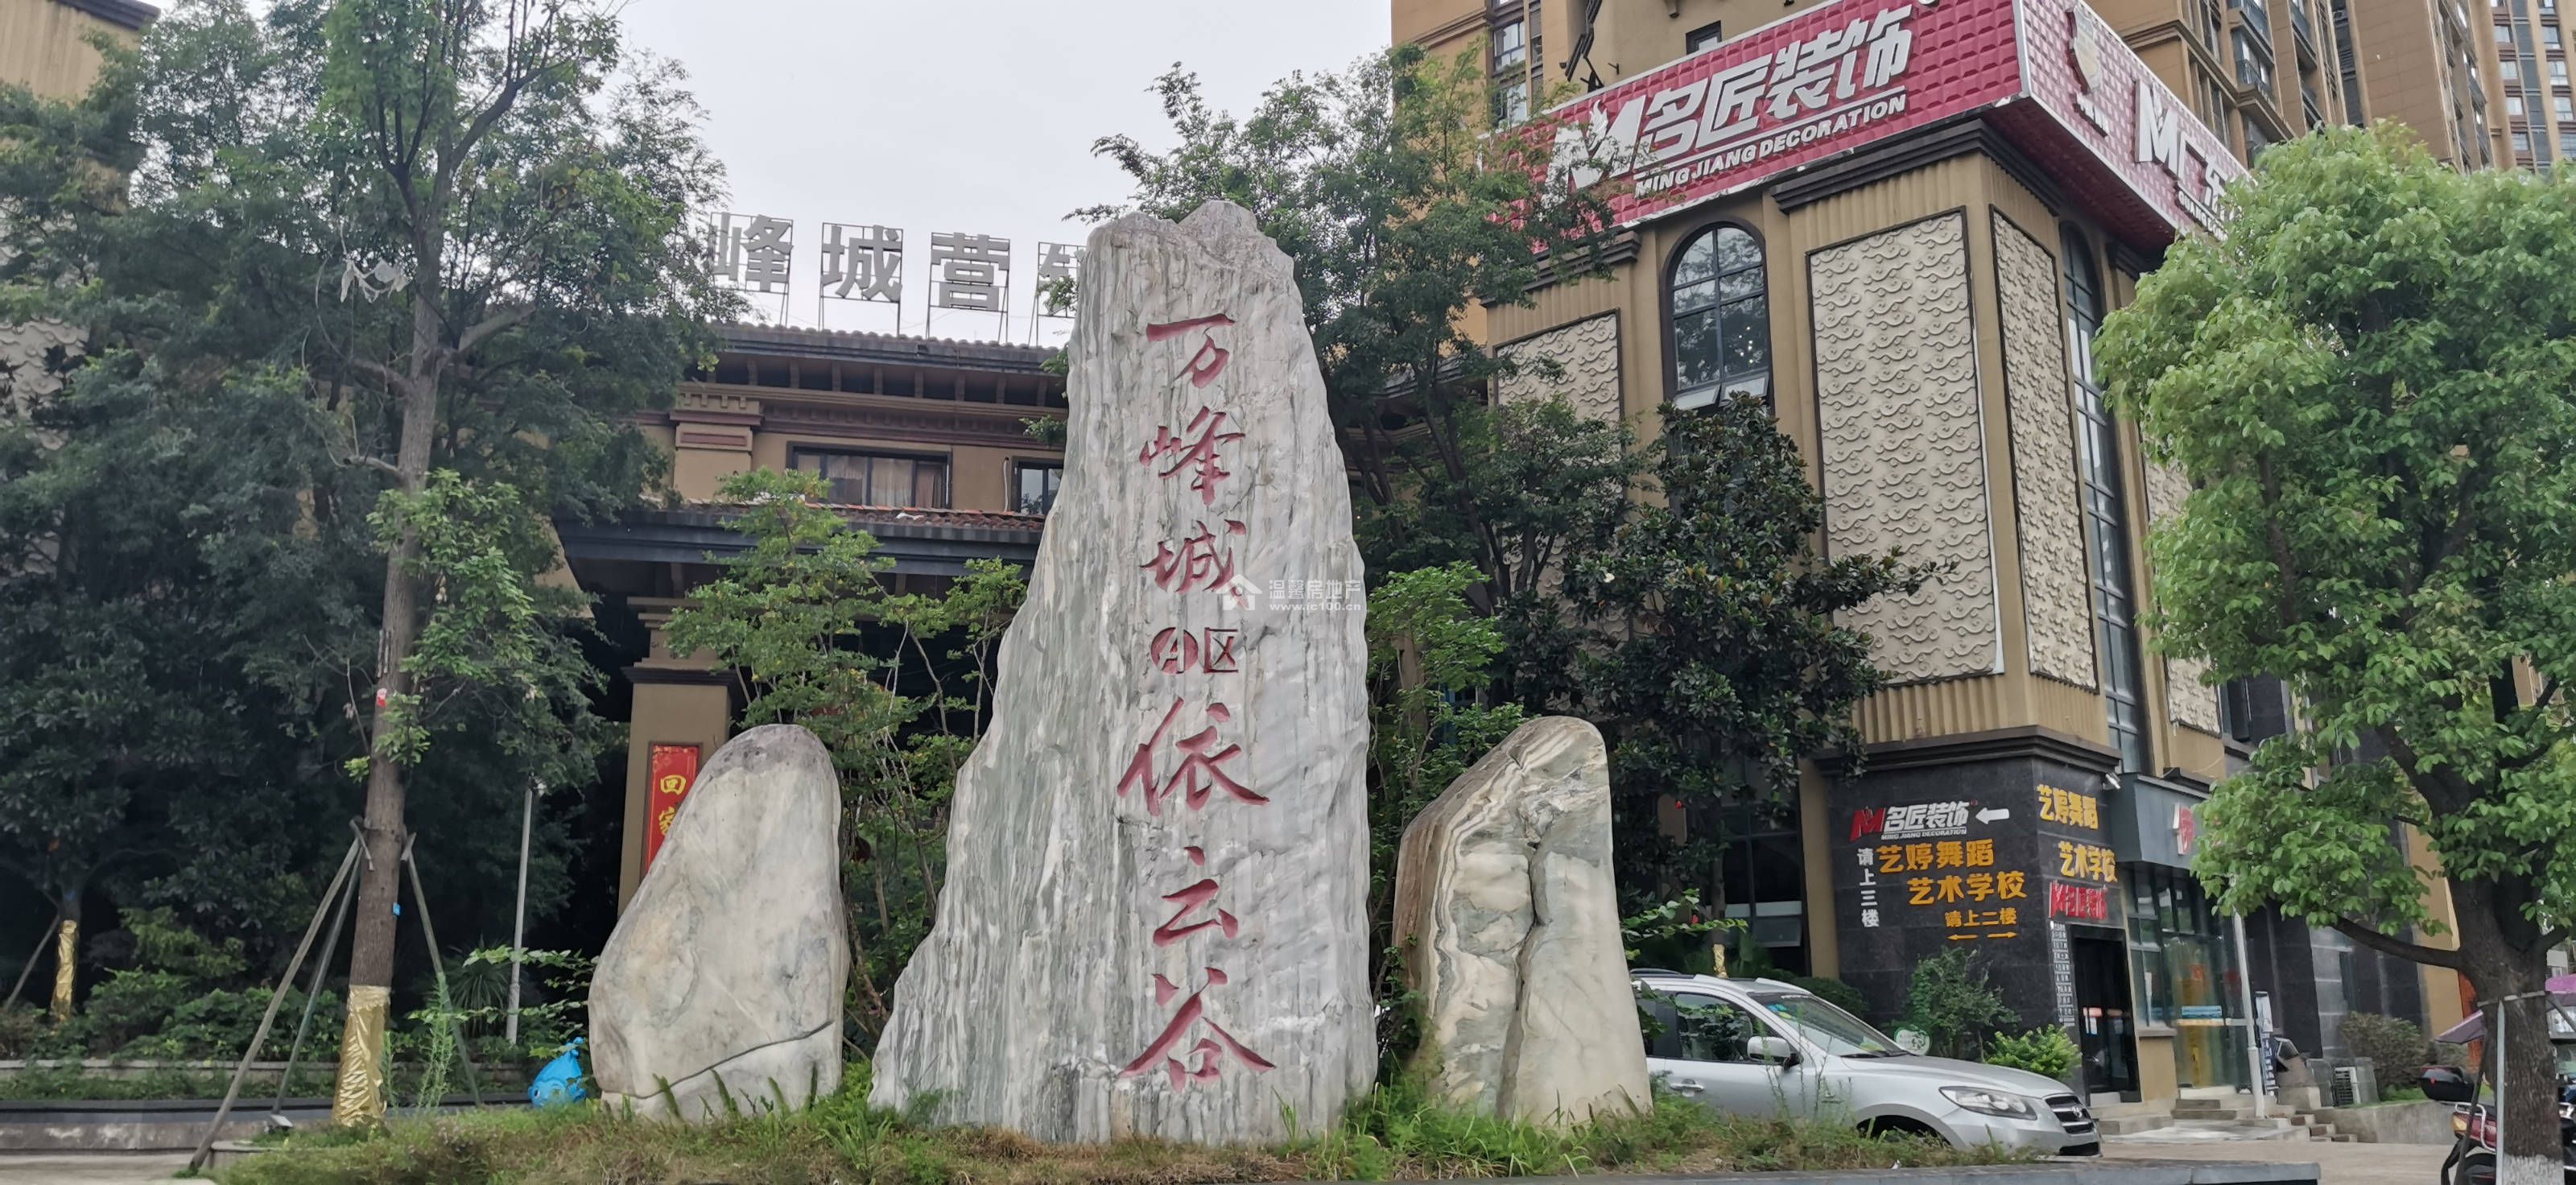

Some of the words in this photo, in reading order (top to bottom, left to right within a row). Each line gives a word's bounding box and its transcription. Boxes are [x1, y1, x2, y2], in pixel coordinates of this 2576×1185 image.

[1633, 4, 1913, 170] 名匠装饰
[1635, 170, 1690, 198] MING
[1694, 146, 1757, 180] JIANG
[1759, 93, 1907, 159] DECORATION
[1883, 800, 1971, 832] 名匠装饰
[1900, 832, 1922, 840] JIANG
[1922, 828, 1968, 838] DECORATION
[1876, 839, 1995, 873] 艺婷舞蹈
[2058, 840, 2118, 883] 艺术学校
[1117, 696, 1277, 1093] 依云谷
[1857, 848, 1880, 927] 请上三楼
[1906, 870, 2028, 906] 艺术学校
[1945, 907, 2017, 927] 请上二楼
